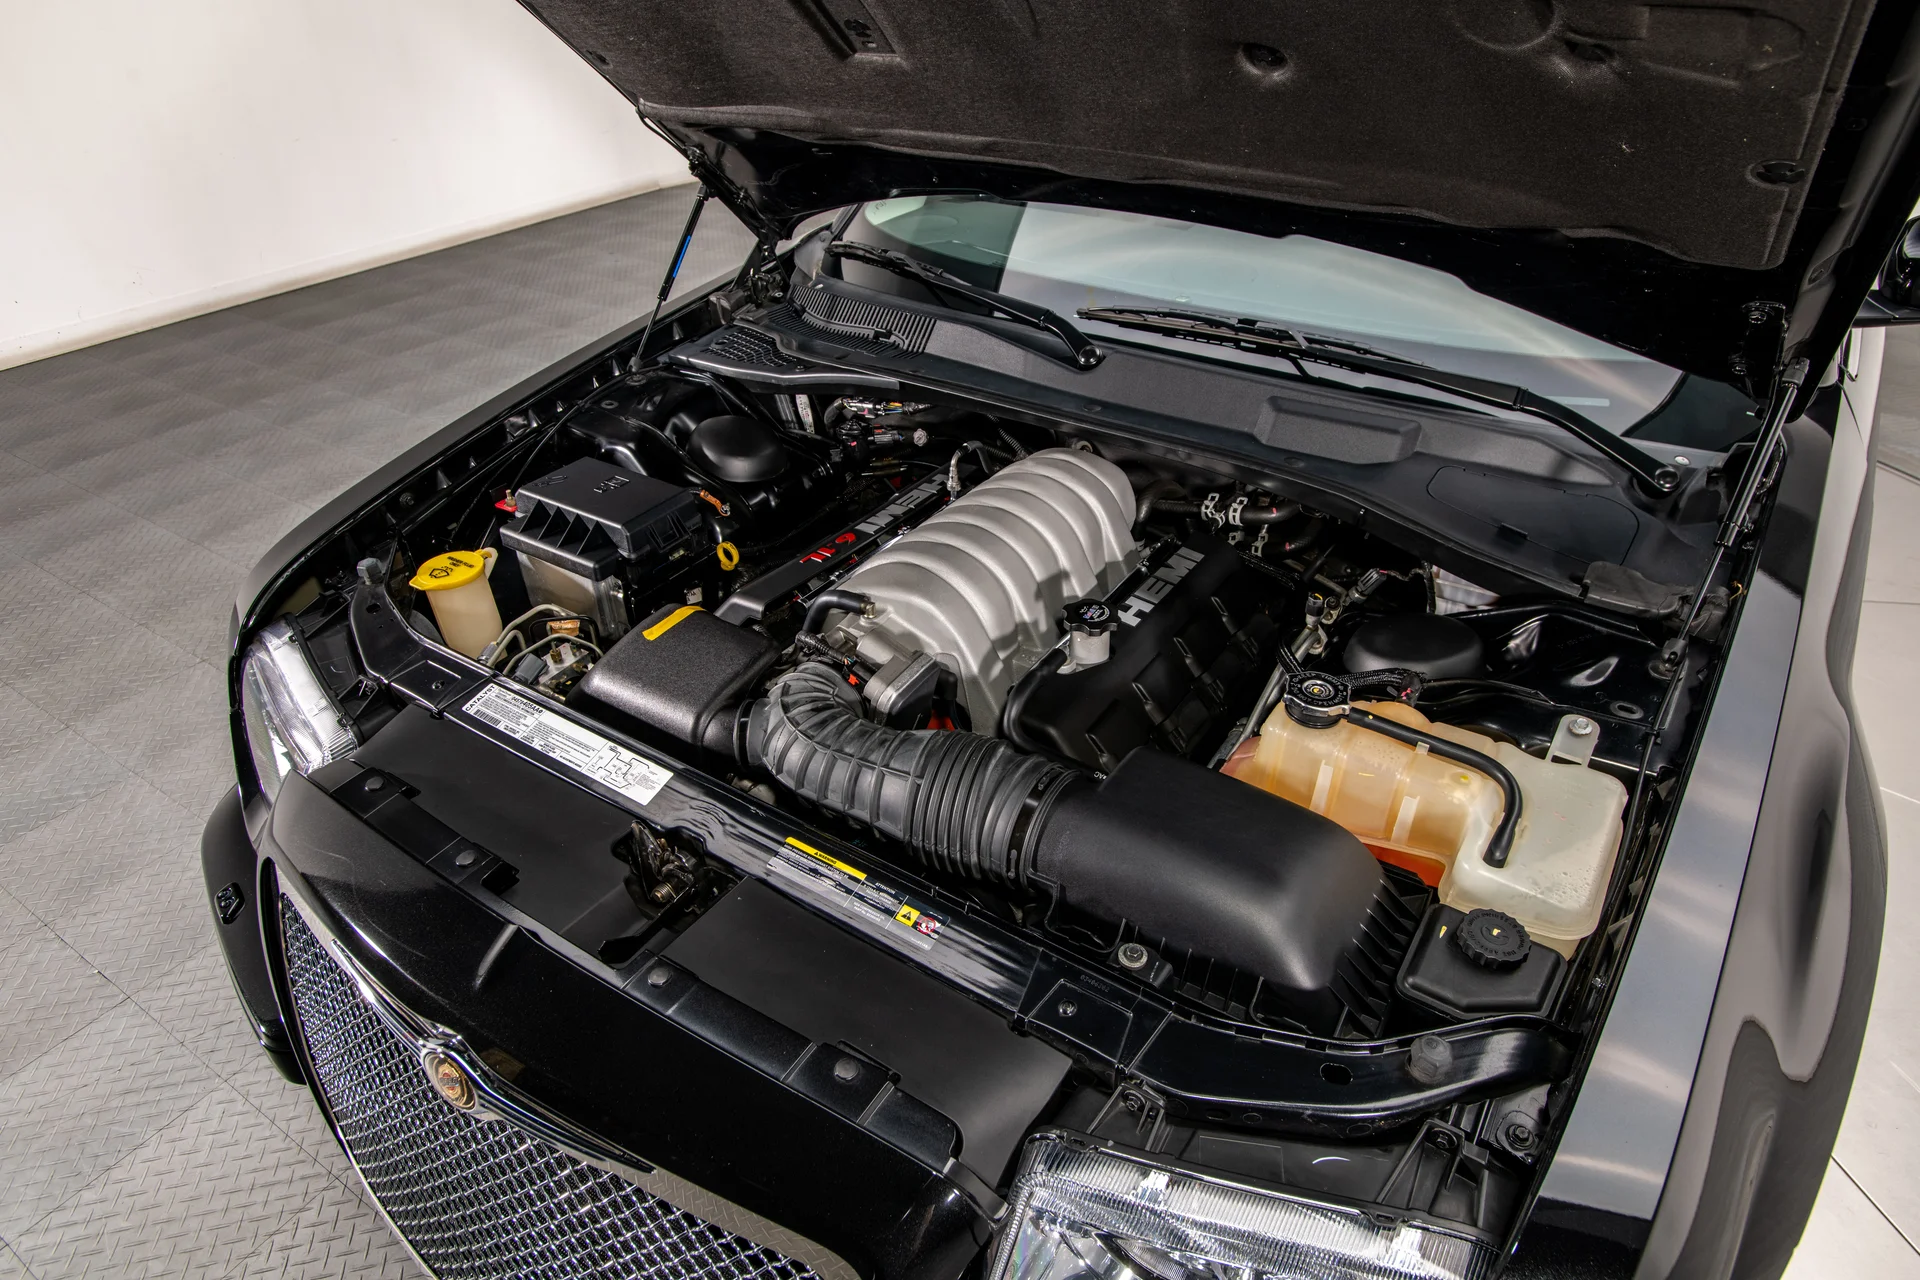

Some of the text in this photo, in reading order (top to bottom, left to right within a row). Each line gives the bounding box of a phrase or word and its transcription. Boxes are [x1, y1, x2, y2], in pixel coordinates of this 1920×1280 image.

[800, 474, 950, 563] HEMI 6.1L
[1118, 546, 1205, 627] HEMI
[465, 685, 496, 712] CATALYST
[818, 853, 837, 865] WARNING
